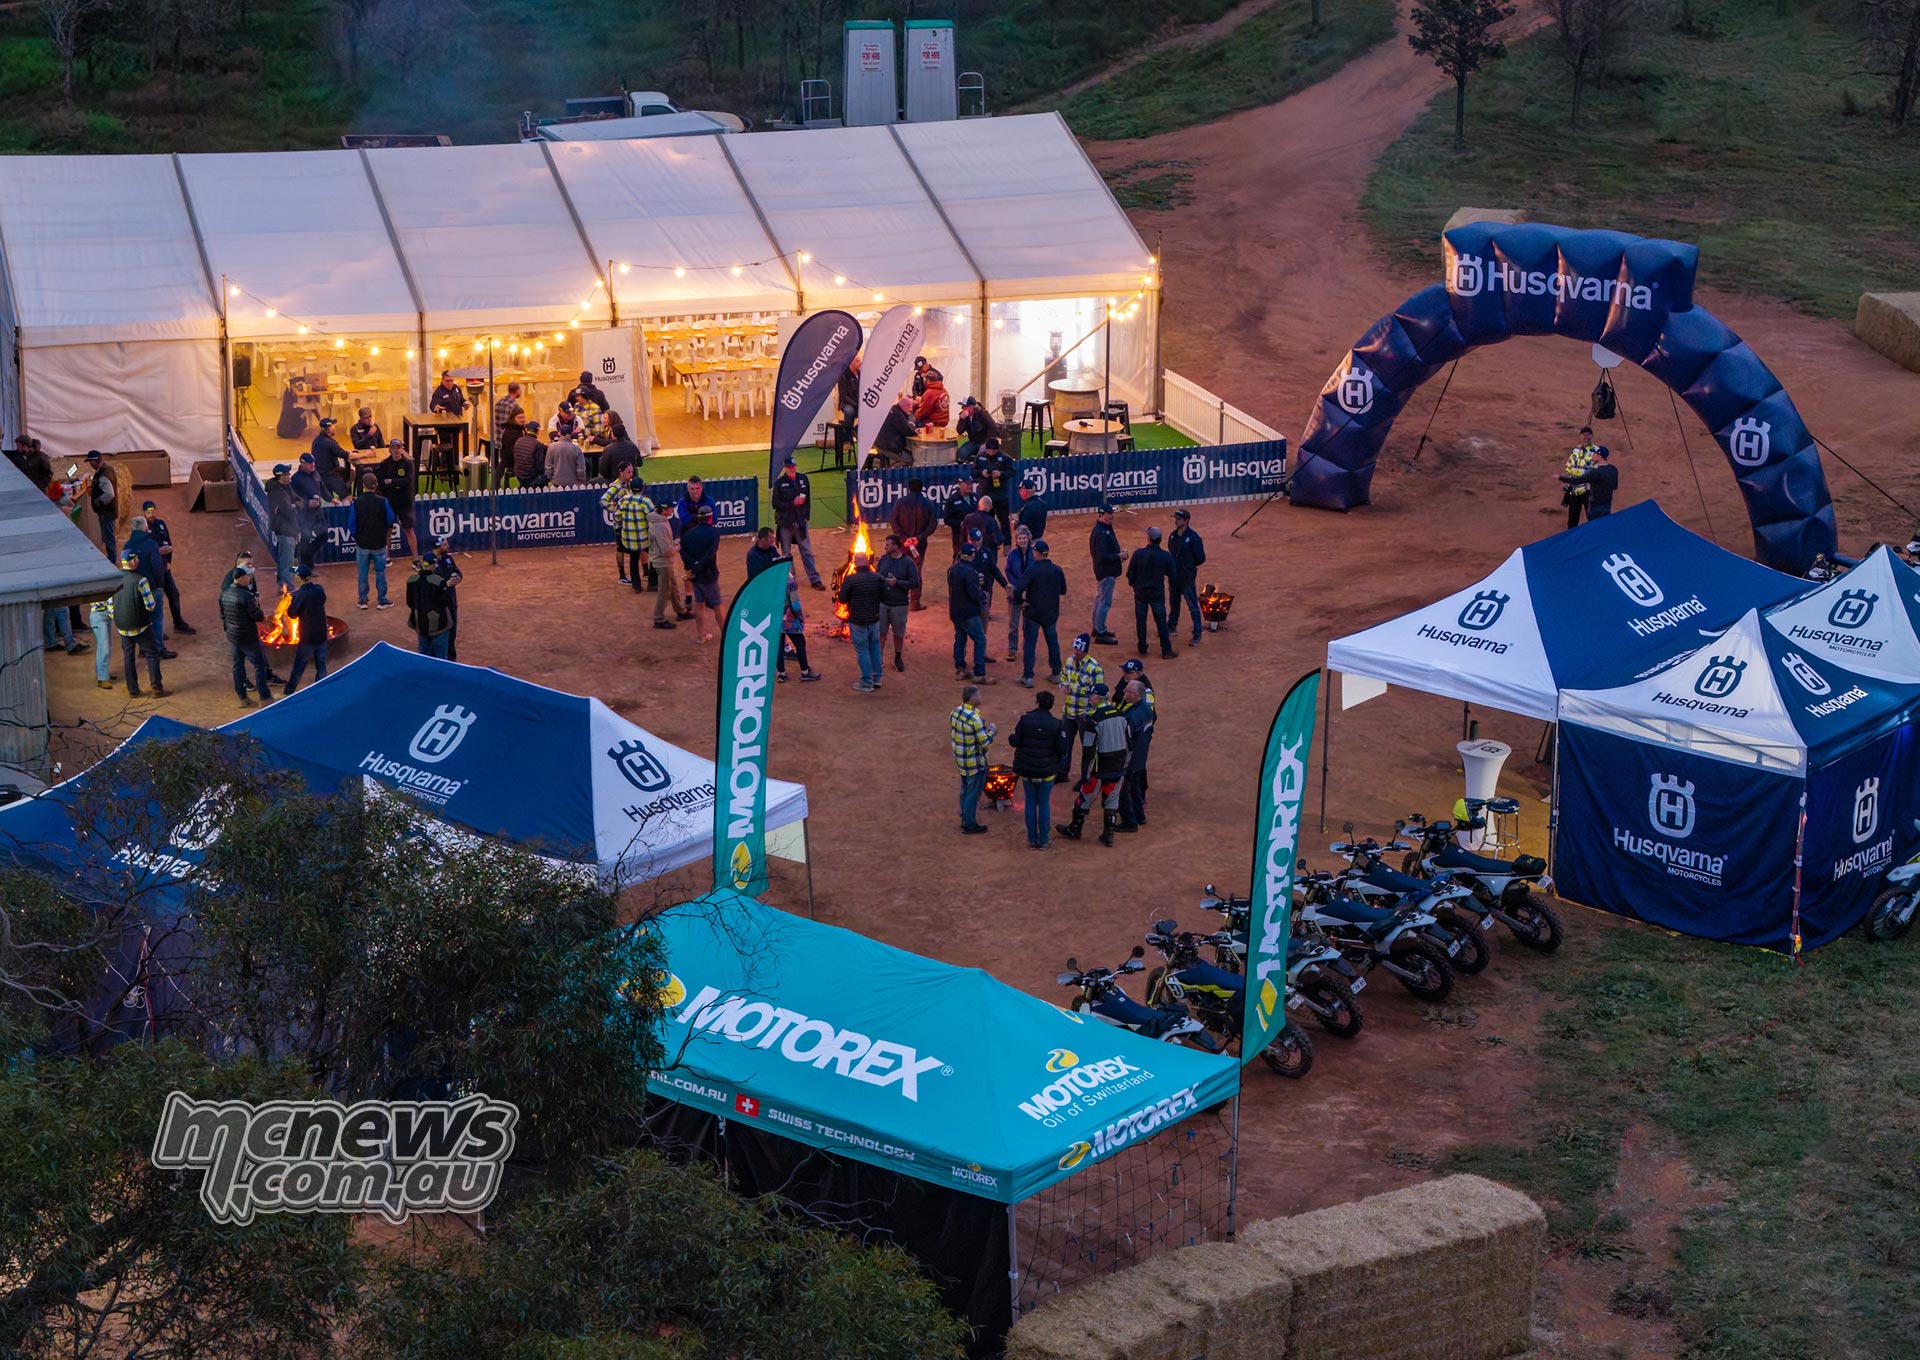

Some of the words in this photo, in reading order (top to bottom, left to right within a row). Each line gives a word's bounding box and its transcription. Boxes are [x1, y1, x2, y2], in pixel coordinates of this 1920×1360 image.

[1487, 261, 1652, 311] Husqvarna
[792, 325, 850, 396] Husqvarna
[873, 322, 915, 393] Husqvarna
[1051, 469, 1158, 492] Husqvarna
[458, 510, 576, 534] Husqvarna
[517, 530, 576, 541] MOTORCYCLES
[1627, 597, 1708, 637] Husqvarna
[1417, 624, 1508, 655] Husqvarna
[1788, 624, 1885, 652] Husqvarna
[1828, 644, 1877, 658] MOTORCYCLES
[1651, 691, 1750, 719] Husqvarna
[1805, 686, 1869, 718] Husqvarna
[727, 613, 772, 839] MOTOREX
[358, 750, 462, 796] Husqvarna
[396, 785, 448, 805] MOTORCYCLES
[622, 783, 716, 822] Husqvarna
[1613, 827, 1724, 875] Husqvarna
[1667, 866, 1722, 886] MOTORCYCLES
[675, 985, 945, 1103] MOTOREX
[1018, 1055, 1140, 1121] MOTOREX
[1043, 1112, 1067, 1128] Oil
[1069, 1102, 1084, 1117] of
[1083, 1070, 1155, 1106] Switzerland
[768, 1108, 813, 1131] SWISS
[815, 1123, 916, 1161] TECHNOLOGY
[1091, 1082, 1200, 1158] MOTOREX
[951, 1166, 998, 1188] MOTOREX
